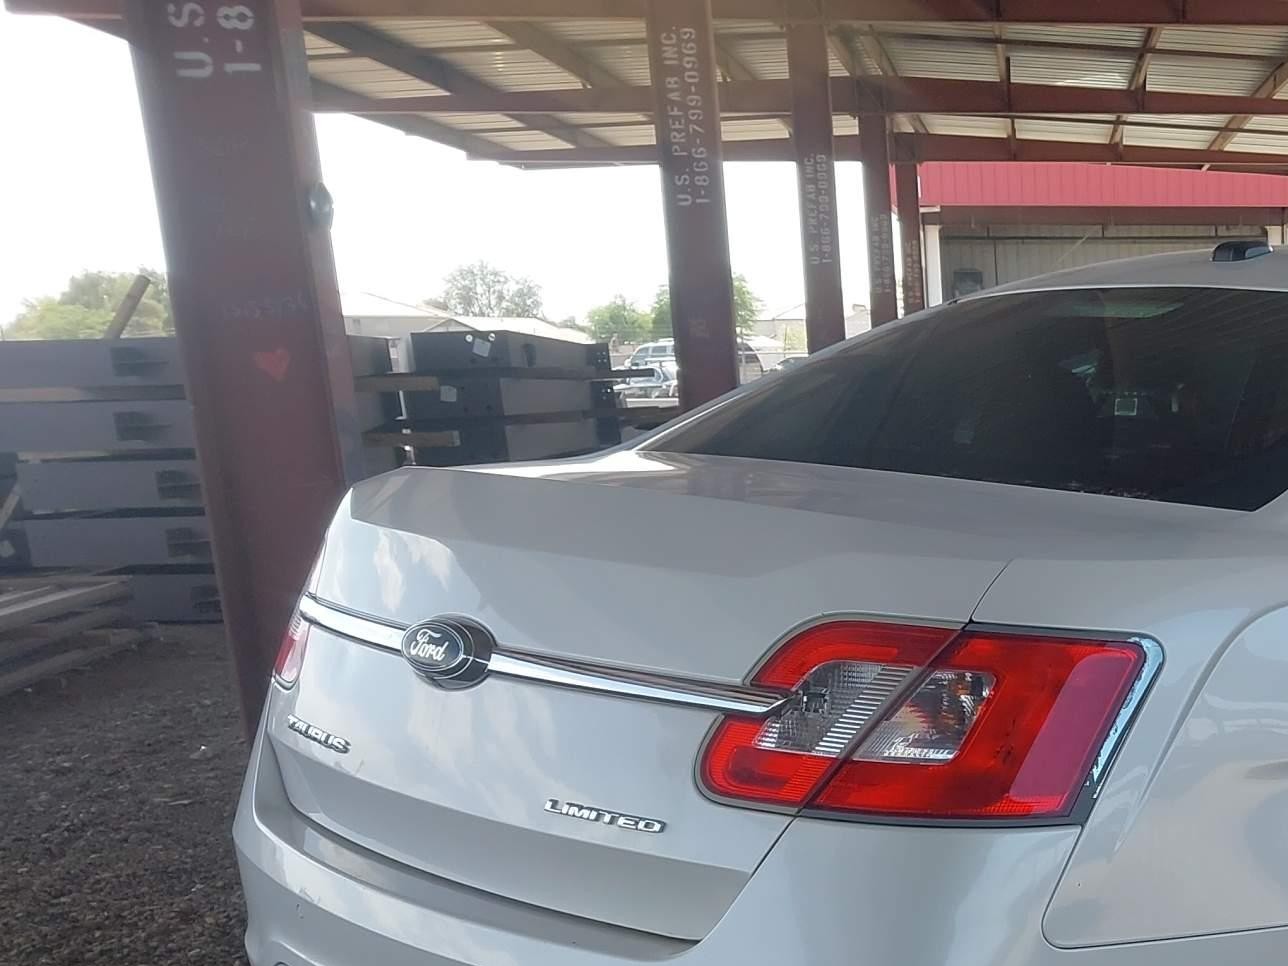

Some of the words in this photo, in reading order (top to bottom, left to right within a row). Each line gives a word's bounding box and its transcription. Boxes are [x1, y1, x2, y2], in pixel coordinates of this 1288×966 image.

[660, 25, 680, 66] INC.
[664, 76, 688, 157] PREFAB
[680, 27, 711, 204] 1-866-799-0969
[674, 167, 693, 207] U.S.
[410, 628, 449, 661] Ford
[287, 713, 352, 754] TAURUS
[544, 799, 667, 833] LIMITED
